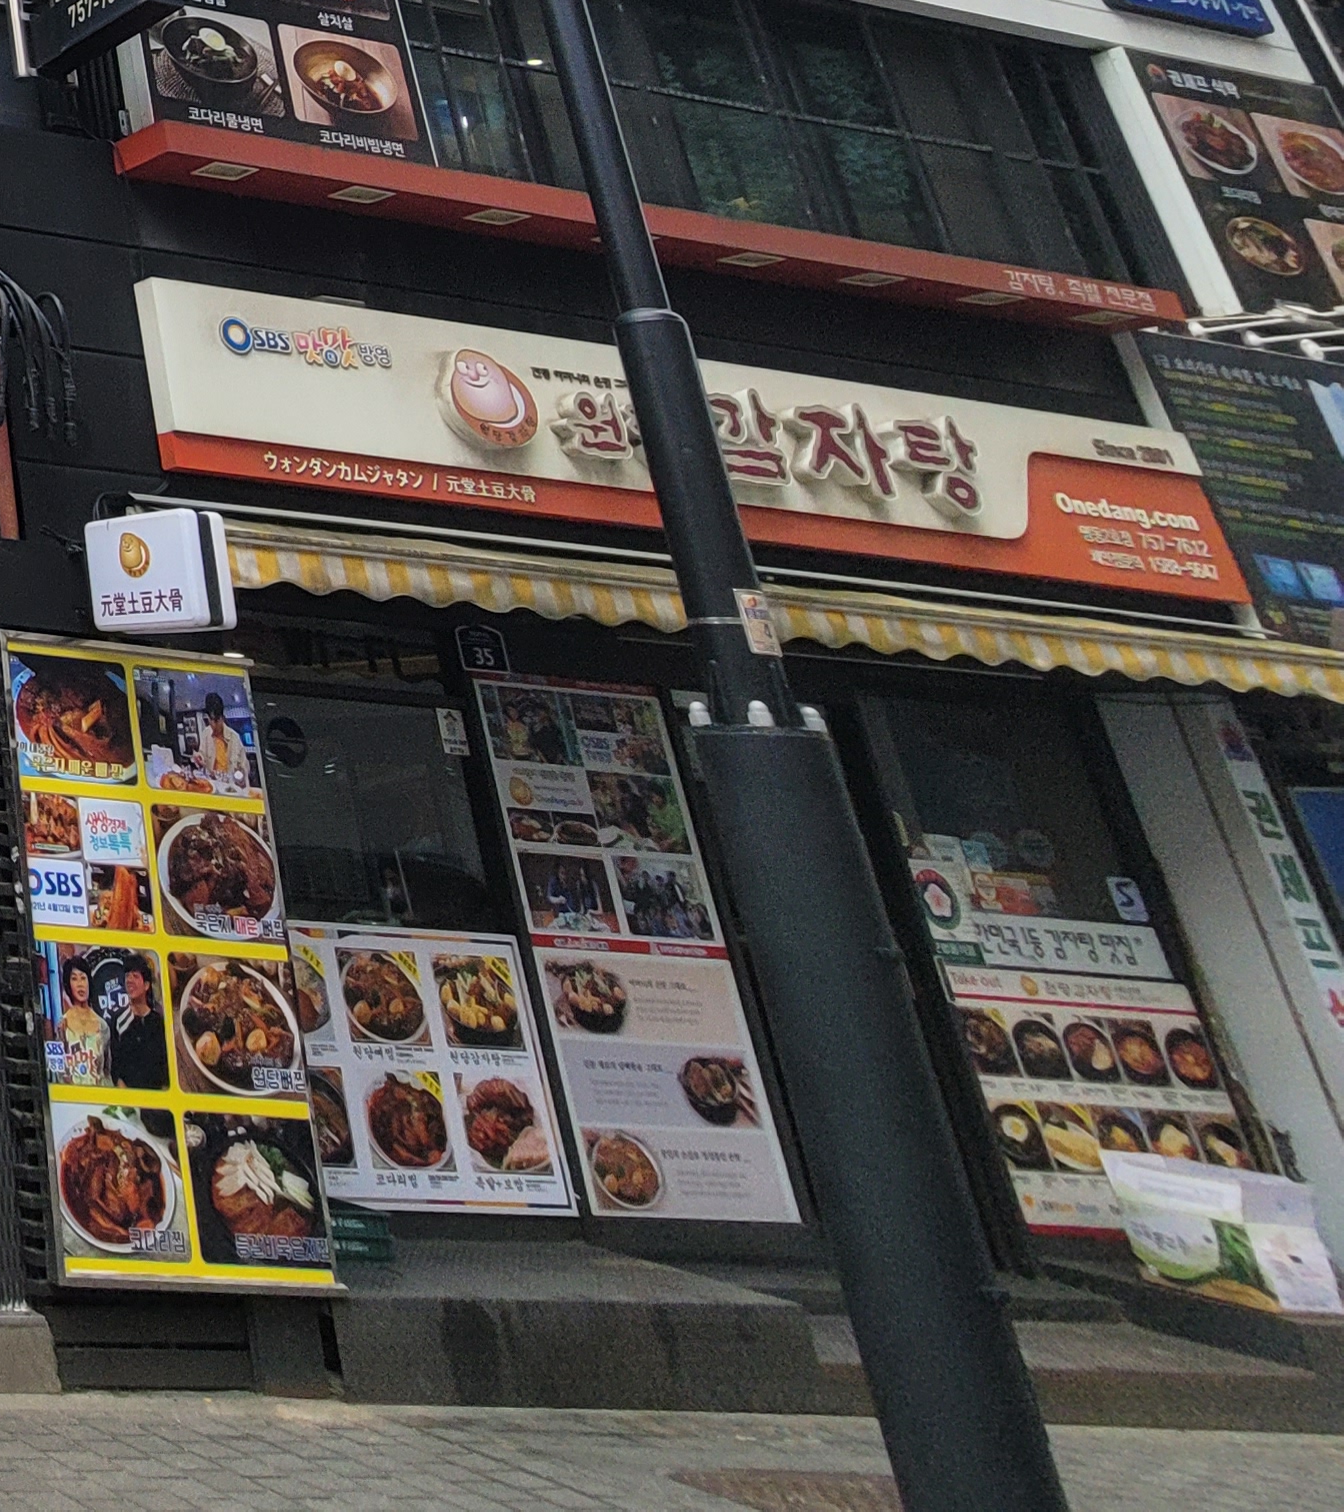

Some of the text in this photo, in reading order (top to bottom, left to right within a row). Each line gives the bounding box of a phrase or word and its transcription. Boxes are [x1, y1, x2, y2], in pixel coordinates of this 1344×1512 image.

[316, 11, 353, 32] 살치살
[188, 106, 406, 157] 코다리물냉면 코다리비빔냉면
[253, 329, 392, 367] SBS 방영
[263, 450, 536, 503] ウォンダンカムジャタン 元堂土豆大骨
[1054, 492, 1200, 531] Onedang.com
[1137, 532, 1213, 558] 757-7612
[101, 590, 183, 618] 元堂土豆大骨
[473, 648, 495, 666] 35
[44, 871, 82, 897] SBS
[195, 912, 231, 933] 묵은지
[234, 915, 258, 936] 매운
[1100, 933, 1140, 966] 맛집
[46, 1043, 64, 1055] SBS
[129, 1228, 186, 1253] 코다리찜
